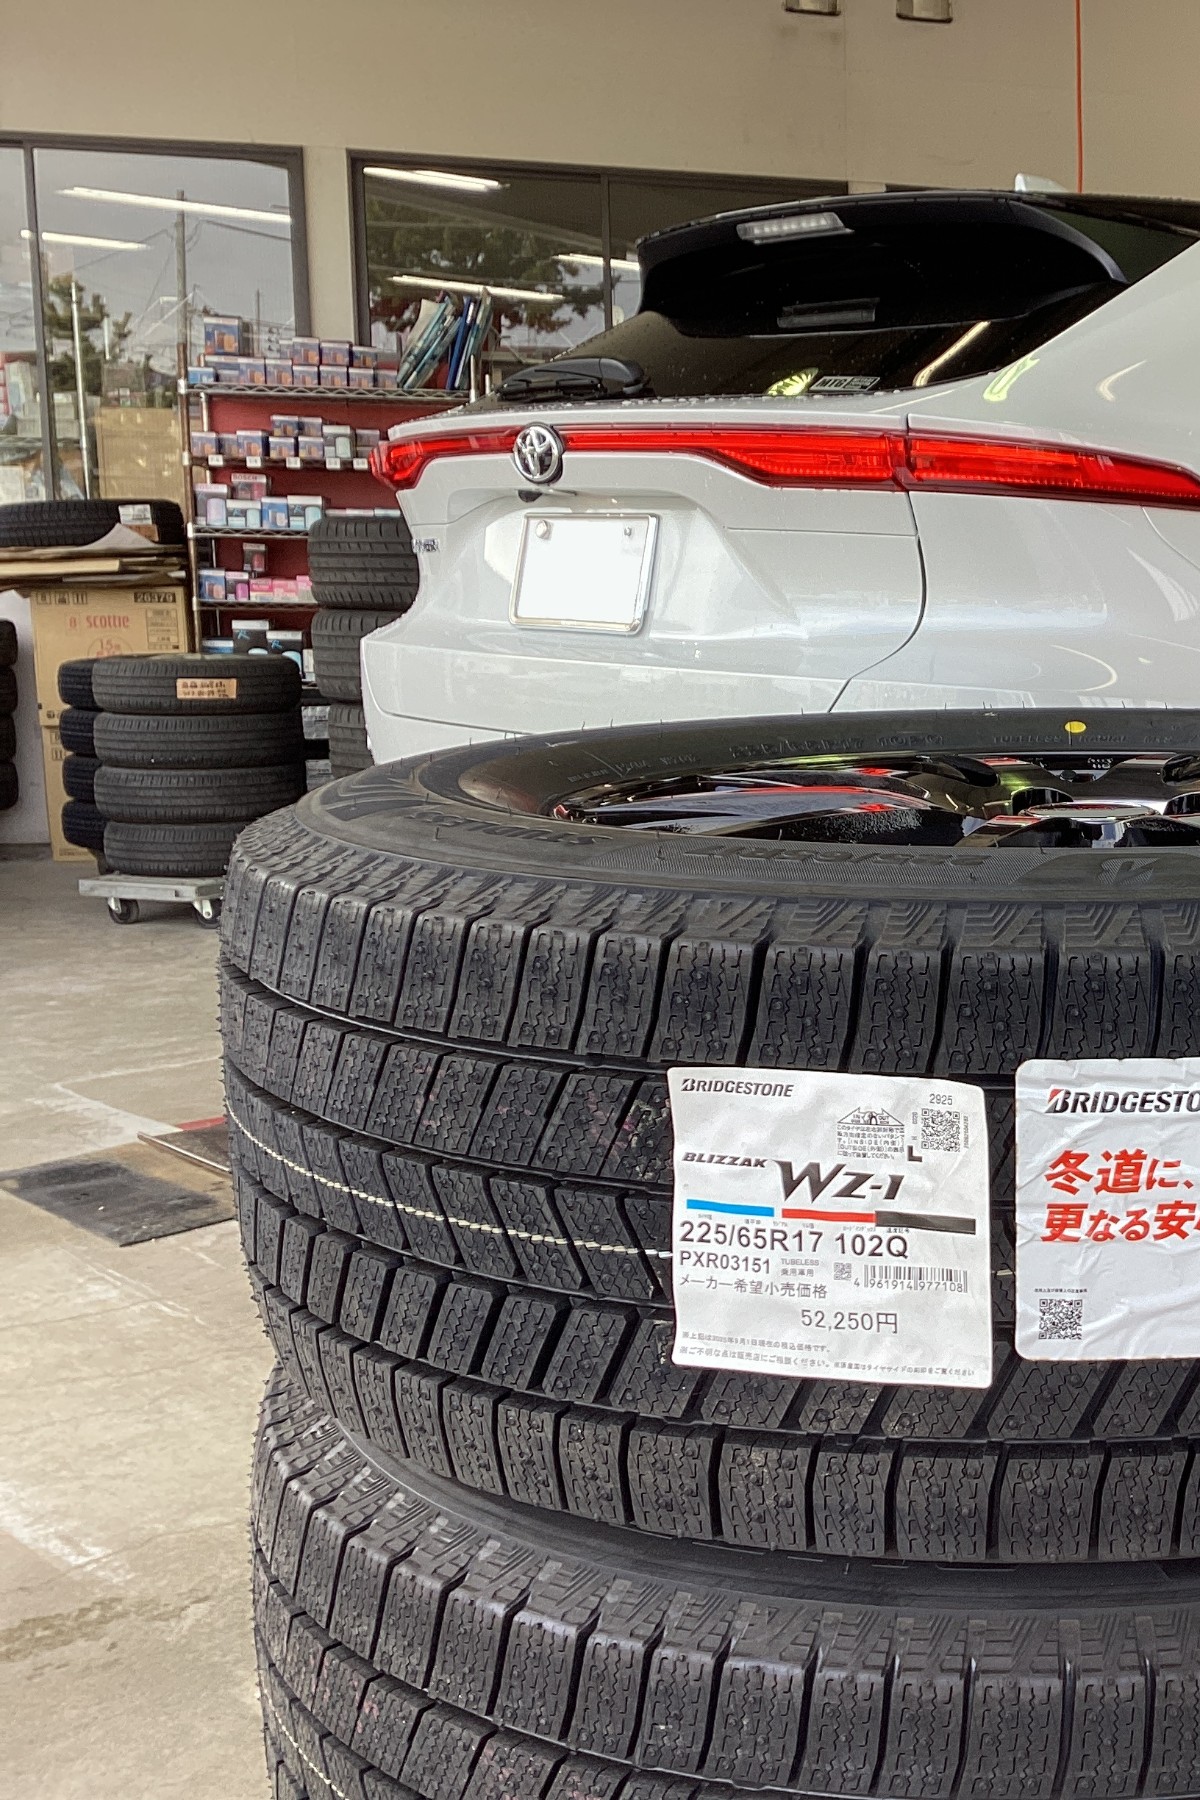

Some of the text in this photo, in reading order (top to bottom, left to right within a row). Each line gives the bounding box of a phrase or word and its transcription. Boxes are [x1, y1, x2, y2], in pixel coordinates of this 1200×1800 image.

[86, 615, 130, 628] scottie
[684, 845, 992, 866] 225/65R17
[681, 1078, 794, 1097] BRIDGESTONE
[929, 1093, 953, 1106] 2925
[681, 1152, 767, 1168] BLIZZAK
[907, 1145, 922, 1162] L
[1044, 1148, 1195, 1195] 冬道に、
[773, 1159, 904, 1204] WZ-1
[679, 1220, 909, 1259] 225/65R17 102Q
[679, 1250, 771, 1274] PXR03151
[780, 1258, 820, 1267] TUBELESS
[780, 1268, 814, 1278] 乗用車用
[679, 1274, 828, 1300] メーカー希望小売価格
[853, 1277, 964, 1293] 4 961914 977108
[801, 1309, 899, 1334] 52,250円
